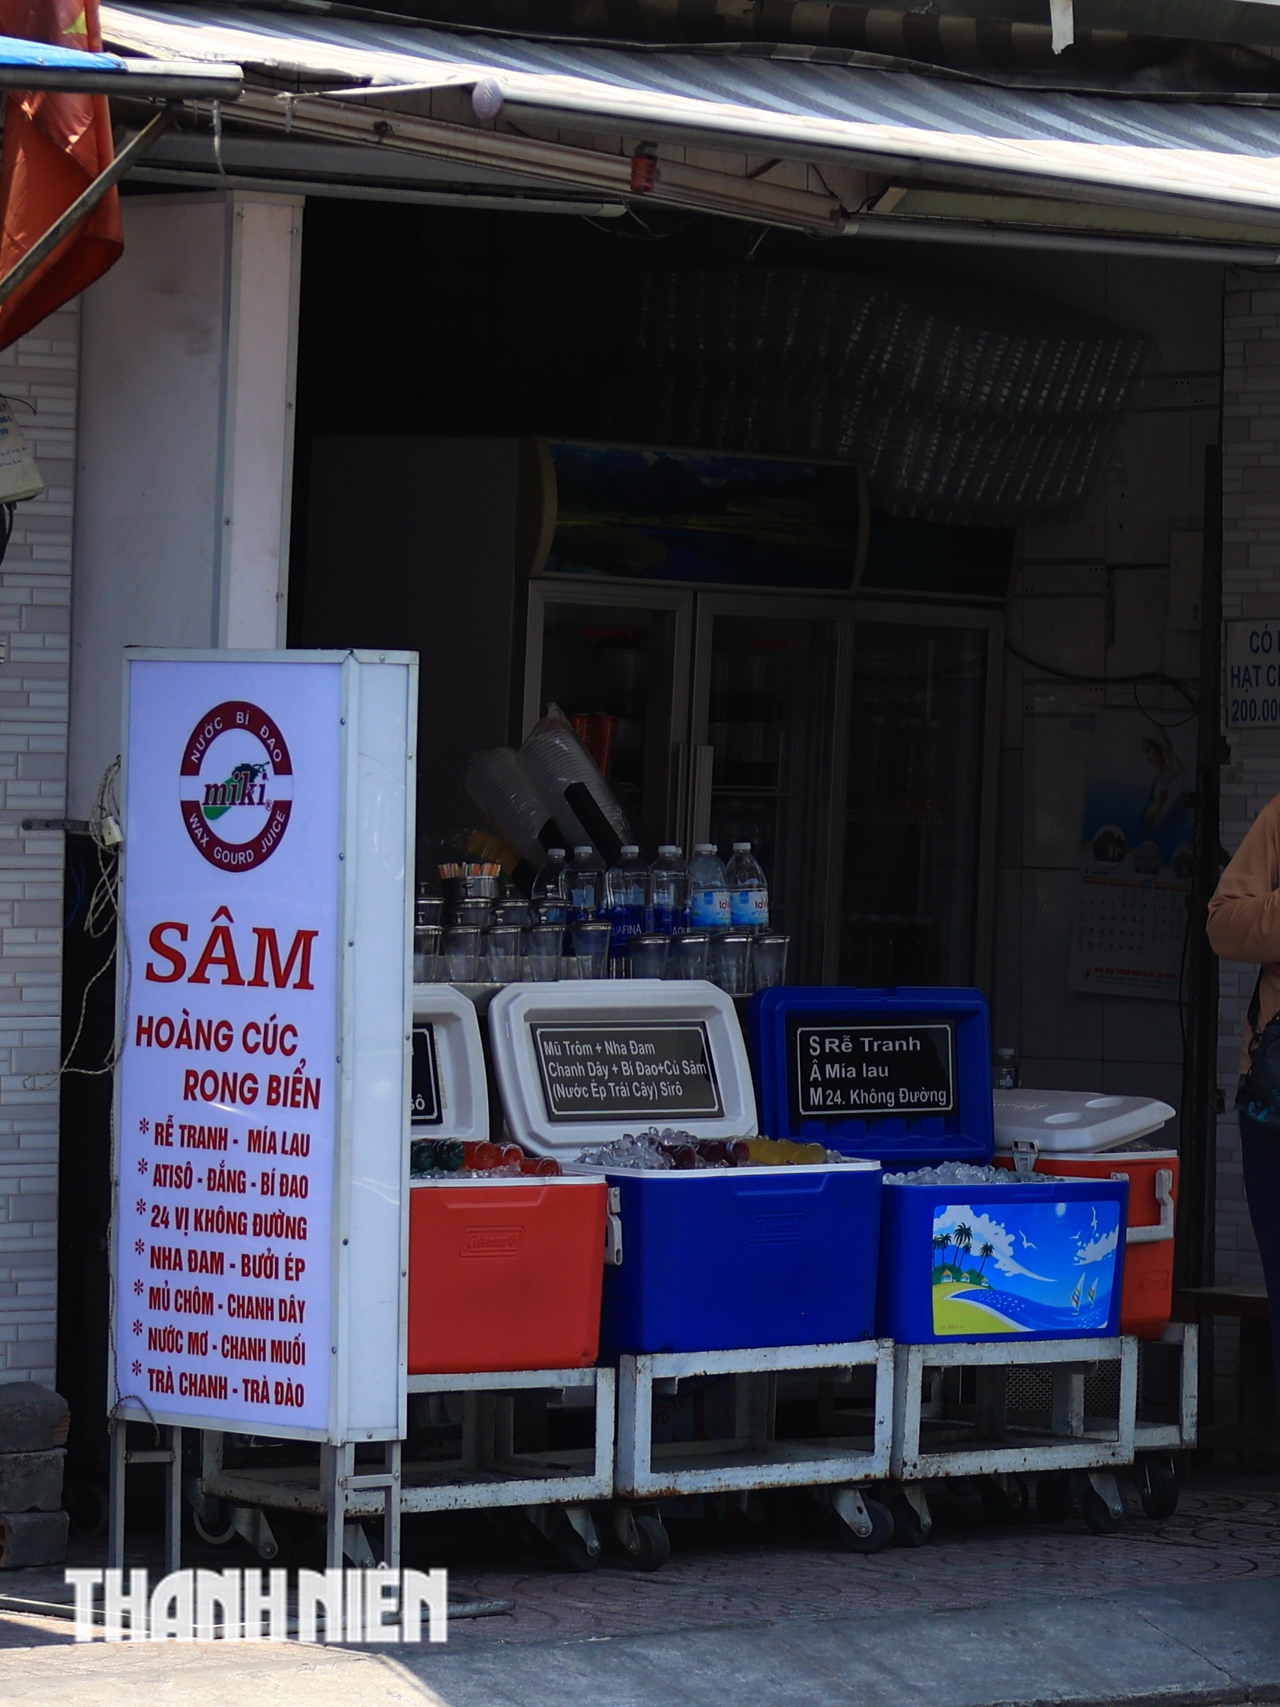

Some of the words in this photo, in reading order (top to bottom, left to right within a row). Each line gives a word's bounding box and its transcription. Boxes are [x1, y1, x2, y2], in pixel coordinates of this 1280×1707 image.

[1249, 624, 1273, 654] CÓ
[1230, 664, 1262, 694] HẠT
[190, 716, 224, 764] NƯỚC
[235, 710, 251, 726] BÍ
[259, 725, 283, 763] ĐAO
[189, 812, 210, 848] WAX
[213, 846, 255, 865] GOURD
[260, 810, 286, 853] JUICE
[145, 906, 319, 990] SÂM
[135, 1008, 234, 1052] HOÀNG
[242, 1013, 299, 1057] CÚC
[563, 1040, 593, 1056] Trôm
[604, 1040, 628, 1055] Nha
[629, 1040, 656, 1055] Đam
[809, 1035, 821, 1056] S
[825, 1034, 853, 1054] Rễ
[859, 1036, 922, 1052] Tranh
[183, 1069, 259, 1106] RONG
[266, 1058, 321, 1110] BIỂN
[548, 1061, 586, 1077] Chanh
[587, 1061, 609, 1080] Dây
[621, 1061, 634, 1076] Bí
[682, 1060, 708, 1075] Sâm
[809, 1058, 822, 1082] Â
[825, 1062, 857, 1079] Mía
[862, 1062, 889, 1078] lau
[552, 1082, 589, 1102] (Nước
[591, 1079, 607, 1101] Ép
[608, 1081, 630, 1097] Trái
[632, 1081, 659, 1101] Cây)
[660, 1080, 683, 1097] Sirô
[809, 1086, 823, 1106] M
[825, 1089, 846, 1106] 24.
[850, 1087, 896, 1108] Không
[898, 1086, 947, 1107] Đường
[154, 1115, 175, 1148] RỄ
[180, 1124, 228, 1151] TRANH
[247, 1123, 278, 1156] MÍA
[281, 1130, 310, 1158] LAU
[152, 1161, 194, 1190] ATISÔ
[206, 1158, 247, 1194] ĐẮNG
[261, 1167, 276, 1197] BÍ
[279, 1173, 309, 1200] ĐAO
[151, 1204, 170, 1229] 24
[174, 1207, 190, 1236] VỊ
[193, 1203, 248, 1237] KHÔNG
[252, 1207, 308, 1241] ĐƯỜNG
[150, 1246, 183, 1272] NHA
[187, 1250, 225, 1276] ĐAM
[241, 1246, 280, 1280] BƯỞI
[284, 1249, 306, 1282] ÉP
[149, 1278, 171, 1312] MỦ
[174, 1285, 214, 1316] CHÔM
[227, 1294, 275, 1321] CHANH
[278, 1290, 306, 1325] DÂY
[148, 1323, 184, 1355] NƯỚC
[187, 1329, 209, 1357] MƠ
[221, 1333, 268, 1363] CHANH
[271, 1331, 306, 1366] MUỐI
[147, 1361, 175, 1395] TRÀ
[179, 1372, 228, 1401] CHANH
[242, 1369, 270, 1405] TRÀ
[274, 1371, 305, 1409] ĐÀO
